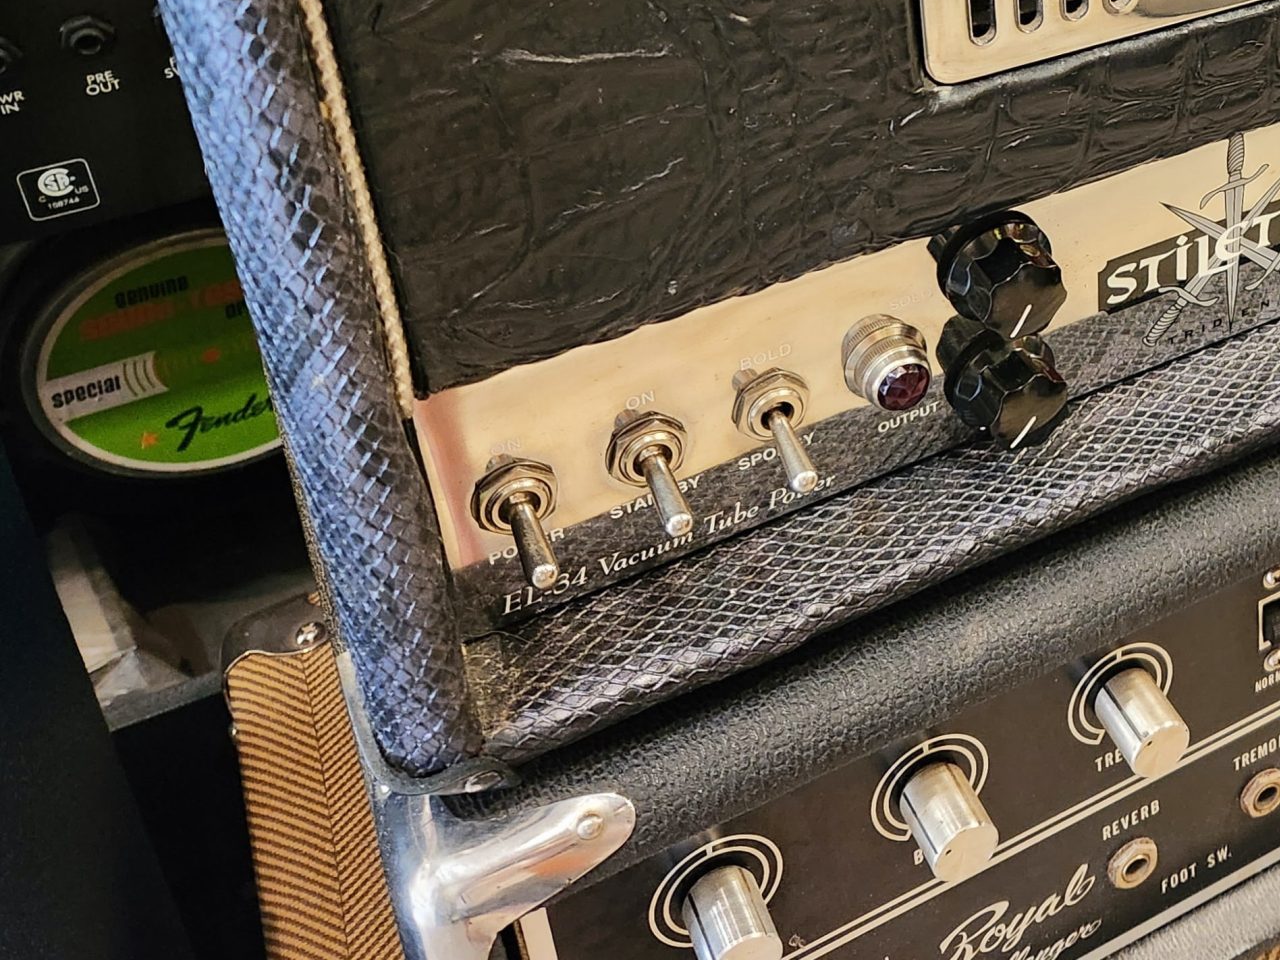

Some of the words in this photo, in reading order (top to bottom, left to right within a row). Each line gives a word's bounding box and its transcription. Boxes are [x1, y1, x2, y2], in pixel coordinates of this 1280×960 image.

[85, 78, 121, 96] OUT
[86, 70, 115, 86] PRE
[0, 90, 25, 104] WR
[1, 101, 20, 115] IN
[740, 343, 793, 371] BOLD
[51, 375, 122, 409] special
[626, 390, 656, 410] ON
[878, 400, 941, 434] OUTPUT
[490, 438, 522, 456] ON
[737, 430, 816, 472] SPOY
[610, 475, 703, 520] STANBY
[488, 527, 566, 566] POR
[502, 565, 589, 616] EL-34
[598, 531, 694, 577] Vacuum
[702, 501, 760, 536] Tube
[1102, 799, 1161, 841] REVERB
[1161, 862, 1199, 894] FOOT
[939, 863, 1097, 960] Royal
